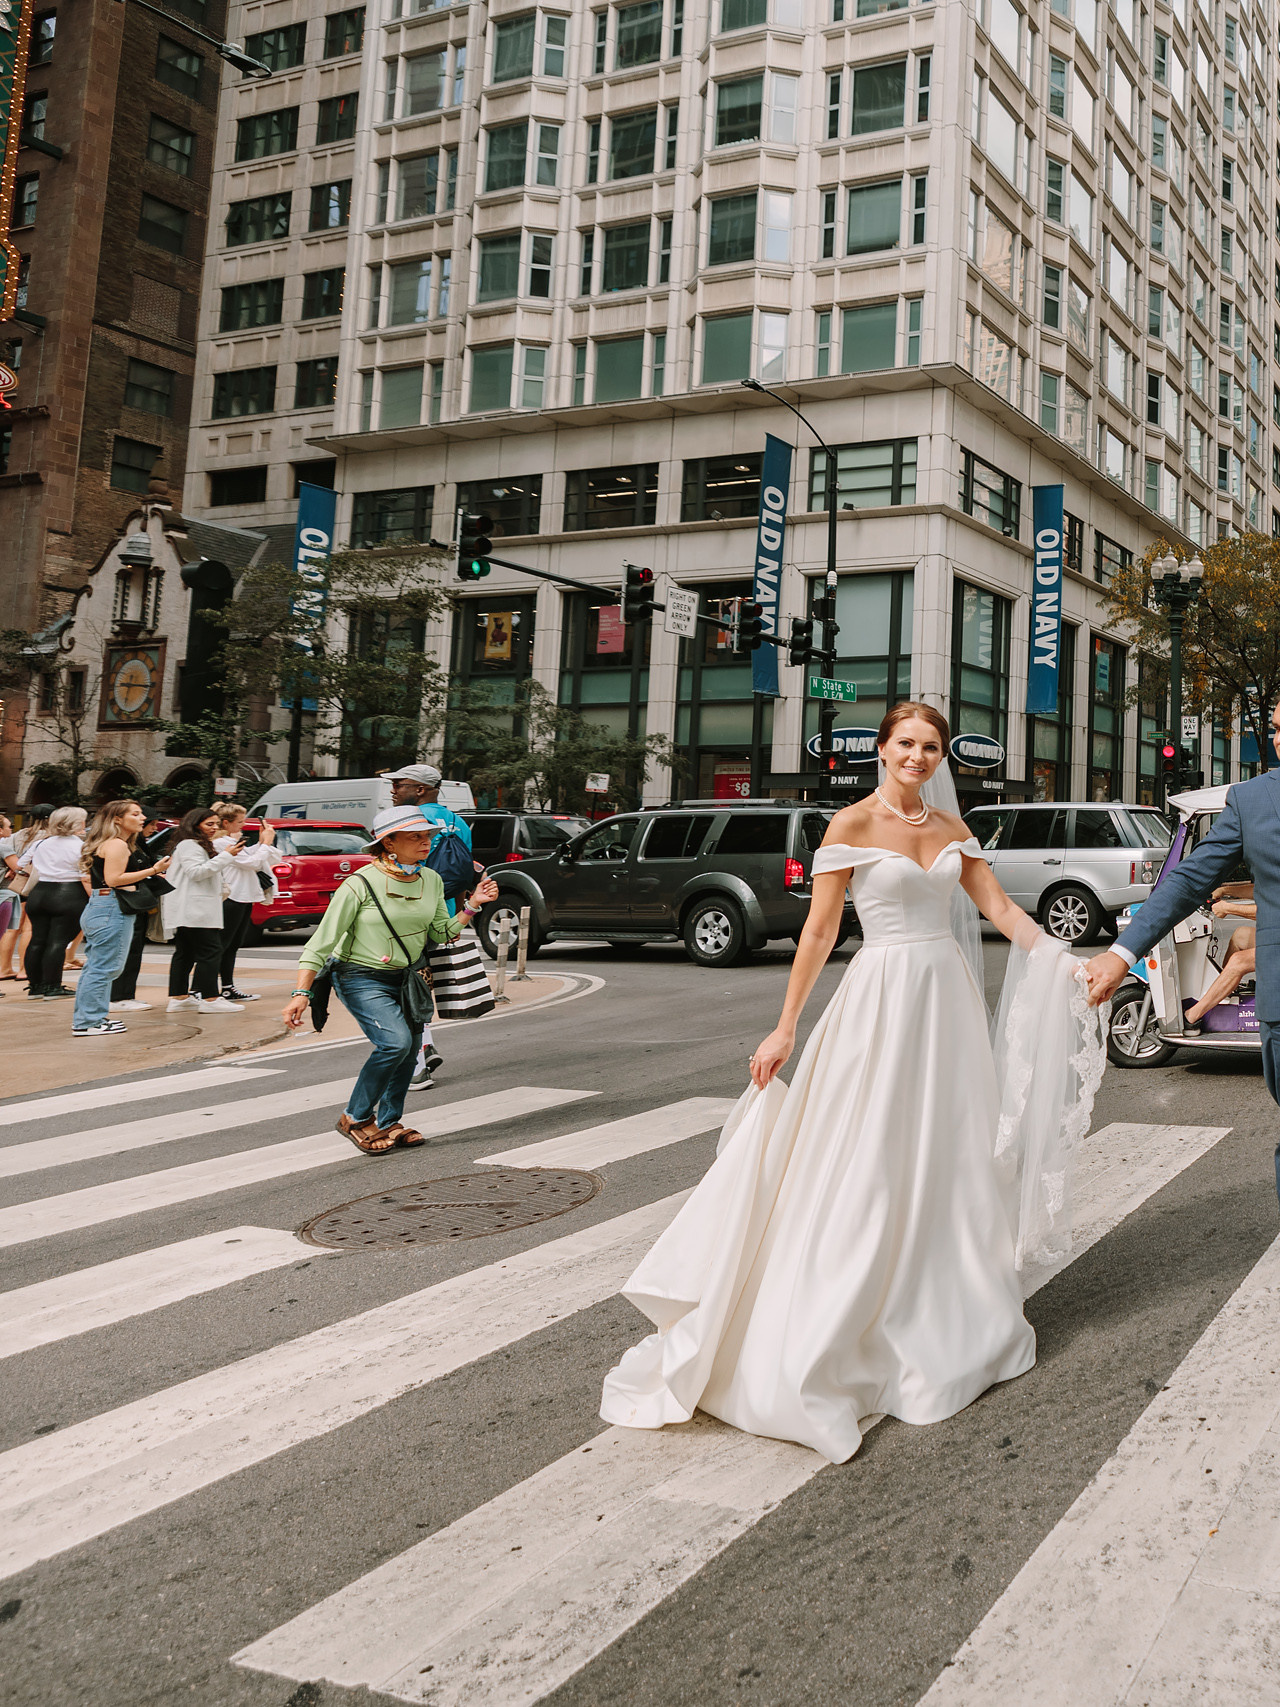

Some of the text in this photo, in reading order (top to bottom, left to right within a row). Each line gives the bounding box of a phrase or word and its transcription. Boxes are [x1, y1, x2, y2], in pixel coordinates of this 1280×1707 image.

[760, 485, 785, 551] OLD
[670, 591, 696, 603] RIGHT ON
[1033, 528, 1060, 669] OLD NAVY
[672, 602, 692, 612] GREEN
[671, 612, 691, 622] ARROW
[672, 622, 688, 631] ONLY
[812, 678, 854, 693] N State St
[831, 691, 844, 700] E/W
[846, 736, 878, 752] NAV
[837, 776, 859, 785] NAVY
